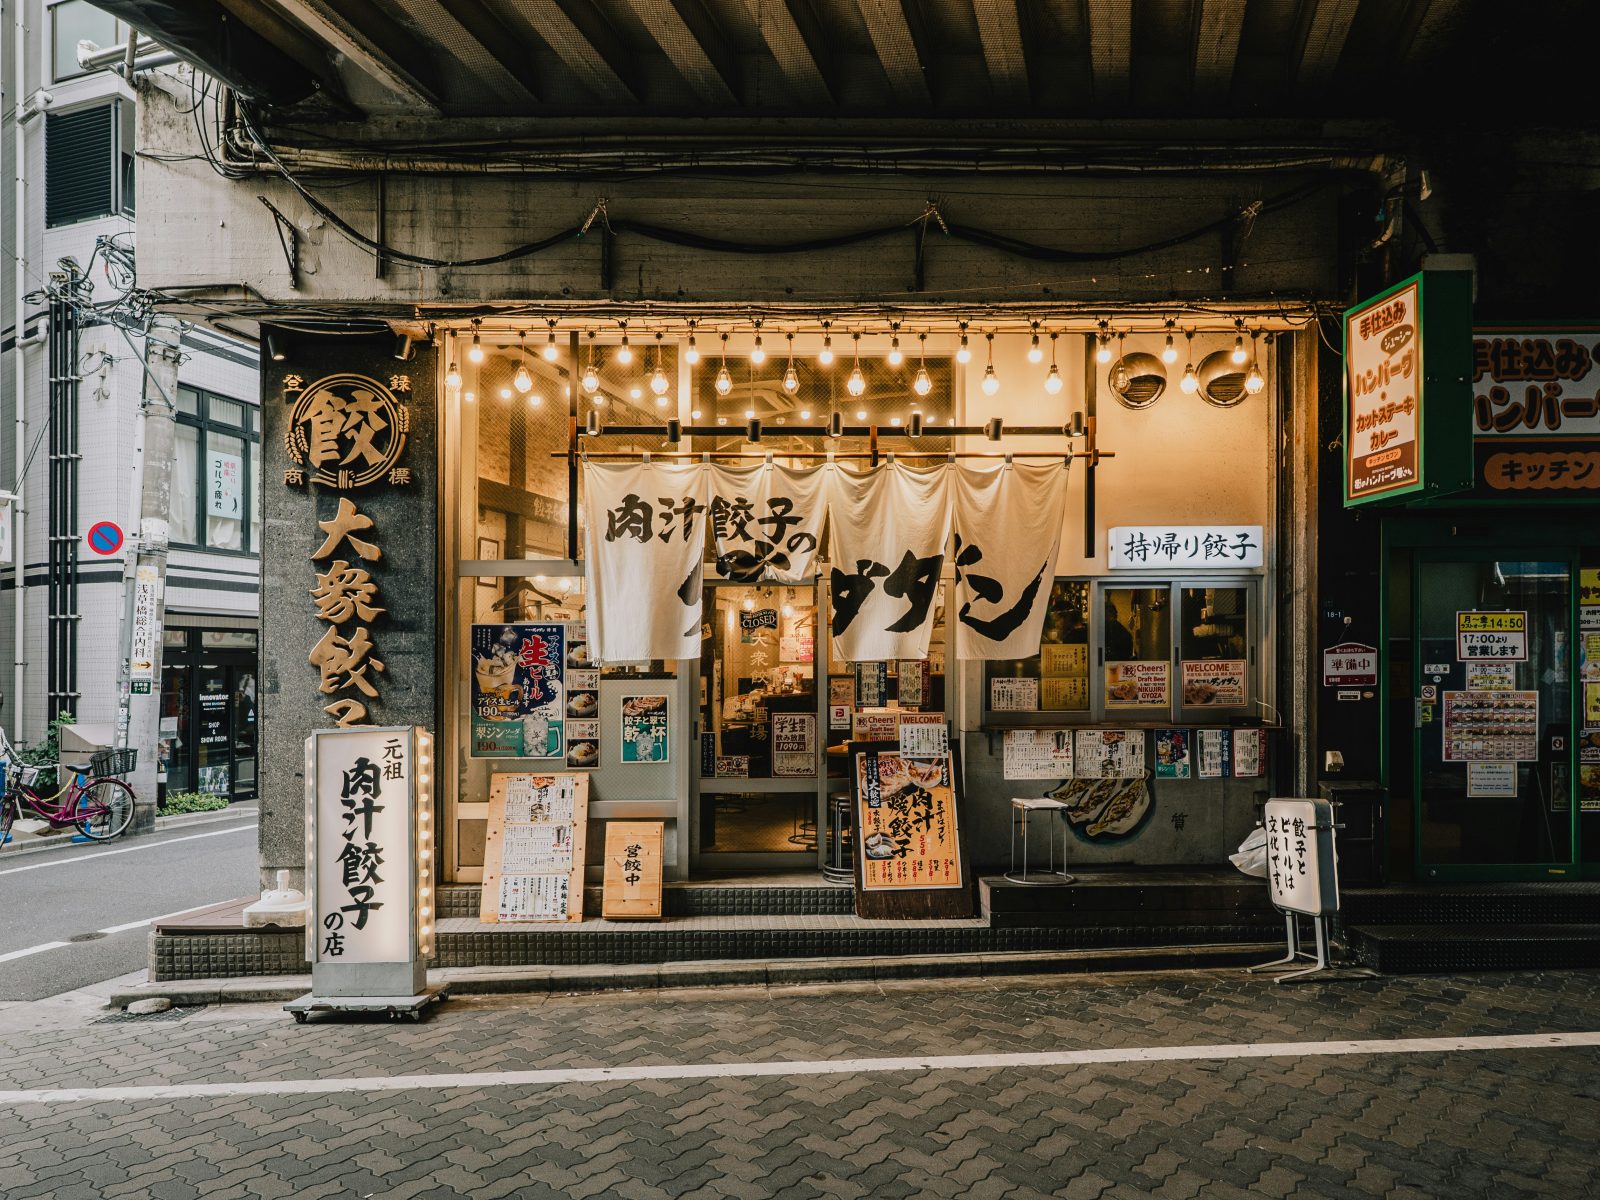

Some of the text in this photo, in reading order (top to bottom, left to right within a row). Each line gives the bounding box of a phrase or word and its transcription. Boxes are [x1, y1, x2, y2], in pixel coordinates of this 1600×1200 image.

[1359, 299, 1406, 340] 手仕込み
[1355, 348, 1414, 397] ハンバーグ
[1356, 395, 1414, 433] カットステーキ
[1474, 383, 1600, 432] ンバー
[1370, 429, 1399, 451] カレー
[1501, 459, 1594, 481] キッチン
[605, 493, 816, 553] 肉汁餃子の
[1124, 532, 1257, 562] 持帰り餃子
[742, 615, 776, 628] CLOSED
[1490, 618, 1523, 628] 14:50
[1463, 634, 1507, 643] 17:00より
[1468, 645, 1519, 656] 営業します
[1136, 664, 1166, 672] Cheers!
[1186, 663, 1230, 672] WELCOME
[1331, 658, 1370, 671] 準備中
[199, 693, 229, 701] Innovator
[775, 716, 798, 733] 学生
[868, 716, 896, 724] Cheers!
[902, 716, 942, 724] WELCOME
[382, 739, 405, 780] 元祖
[912, 787, 935, 832] 肉汁
[887, 793, 914, 858] 焼餃子
[335, 756, 385, 930] 肉汁餃子
[1269, 815, 1283, 896] 文化です。
[1281, 817, 1295, 890] ビールは
[1292, 817, 1307, 875] 餃子と
[322, 912, 345, 957] の店
